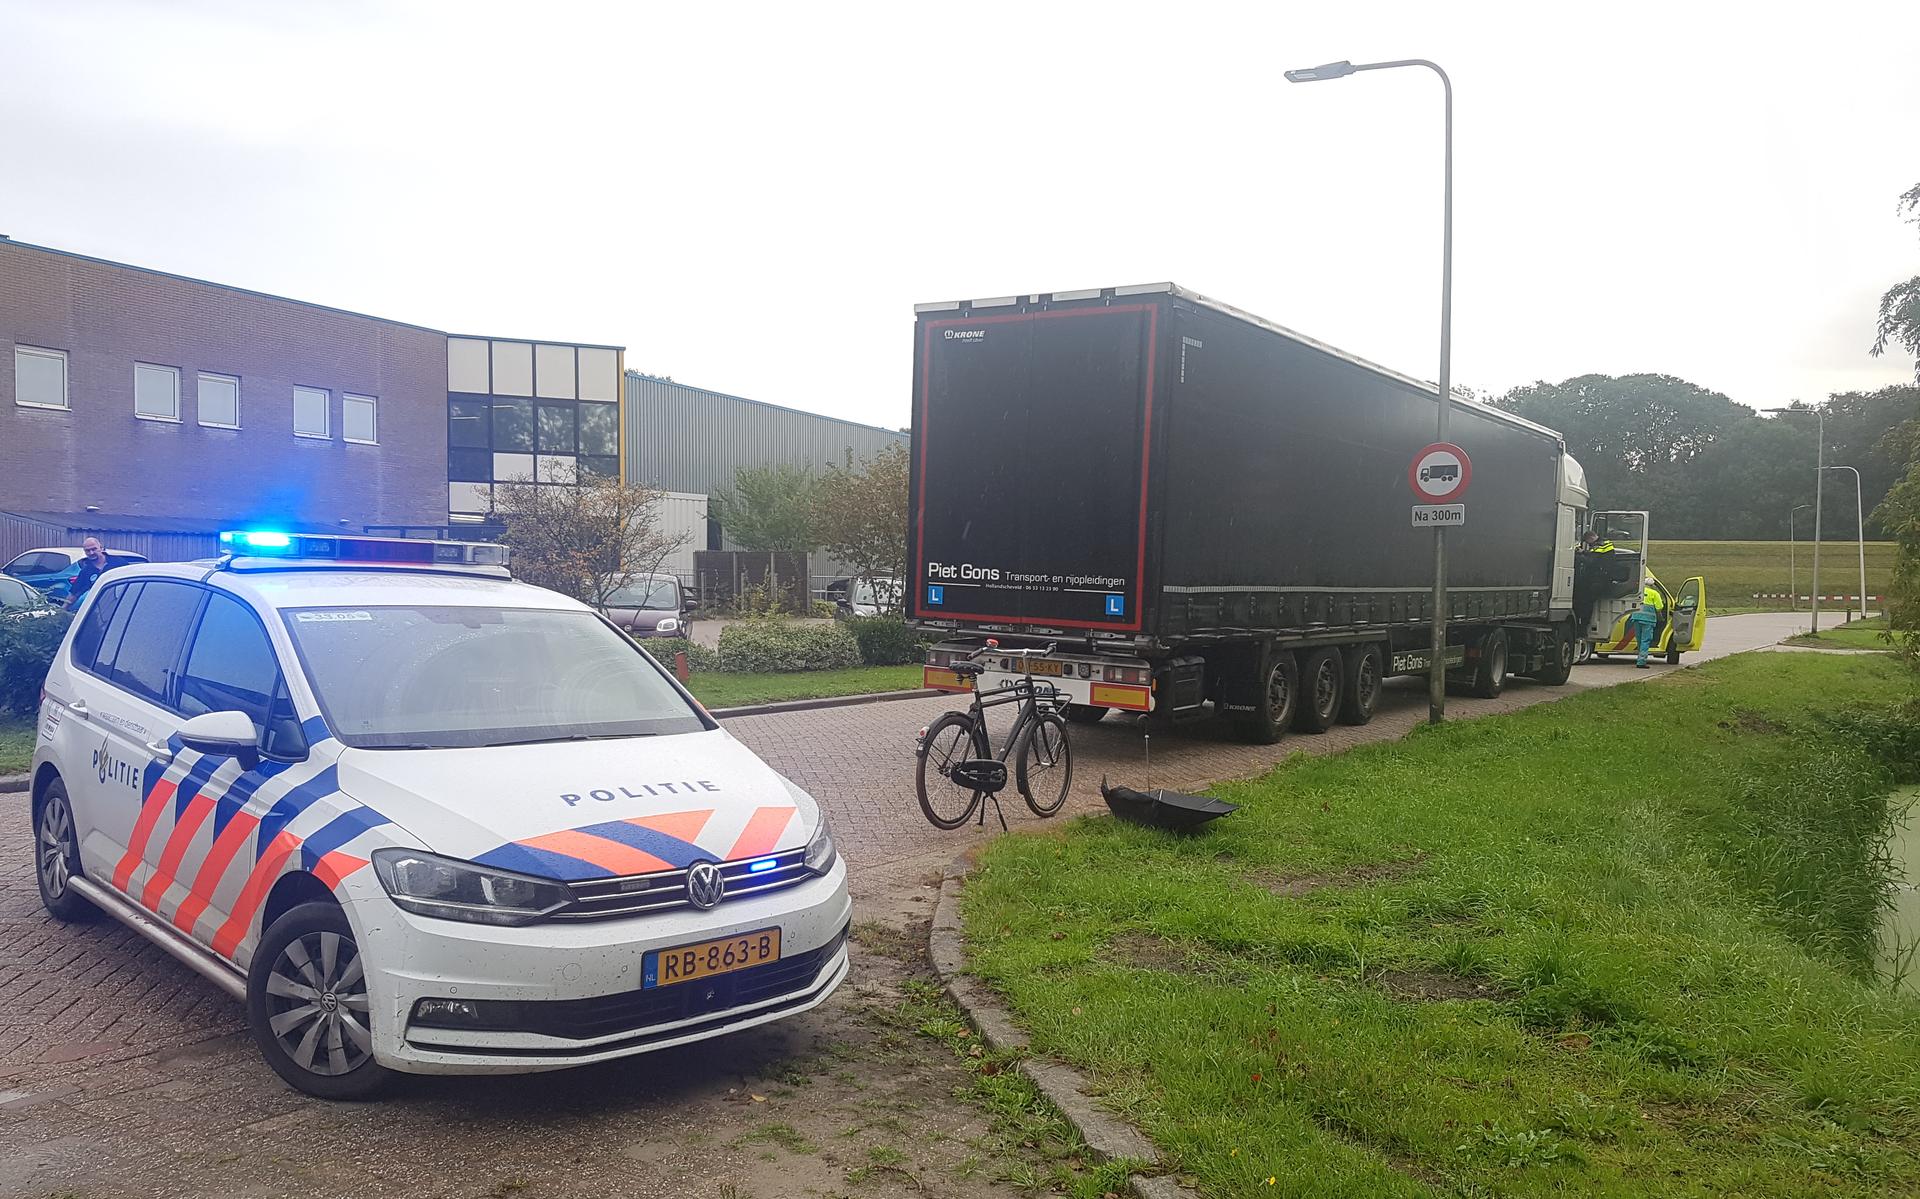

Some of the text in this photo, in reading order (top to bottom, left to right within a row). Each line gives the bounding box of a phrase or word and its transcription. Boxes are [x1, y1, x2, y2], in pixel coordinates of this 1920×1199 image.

[953, 330, 985, 339] KRONE
[1414, 510, 1461, 521] Na 300m
[928, 562, 958, 578] Piet
[961, 563, 1000, 581] Gons
[1052, 575, 1063, 583] en
[1065, 574, 1125, 588] rijopleidingen
[931, 588, 939, 601] L
[1110, 599, 1119, 612] L
[1392, 655, 1406, 672] Piet
[1406, 654, 1423, 670] Gons
[92, 748, 139, 790] POLITIE
[559, 780, 721, 807] POLITIE
[645, 936, 771, 982] NL RB-863-B
